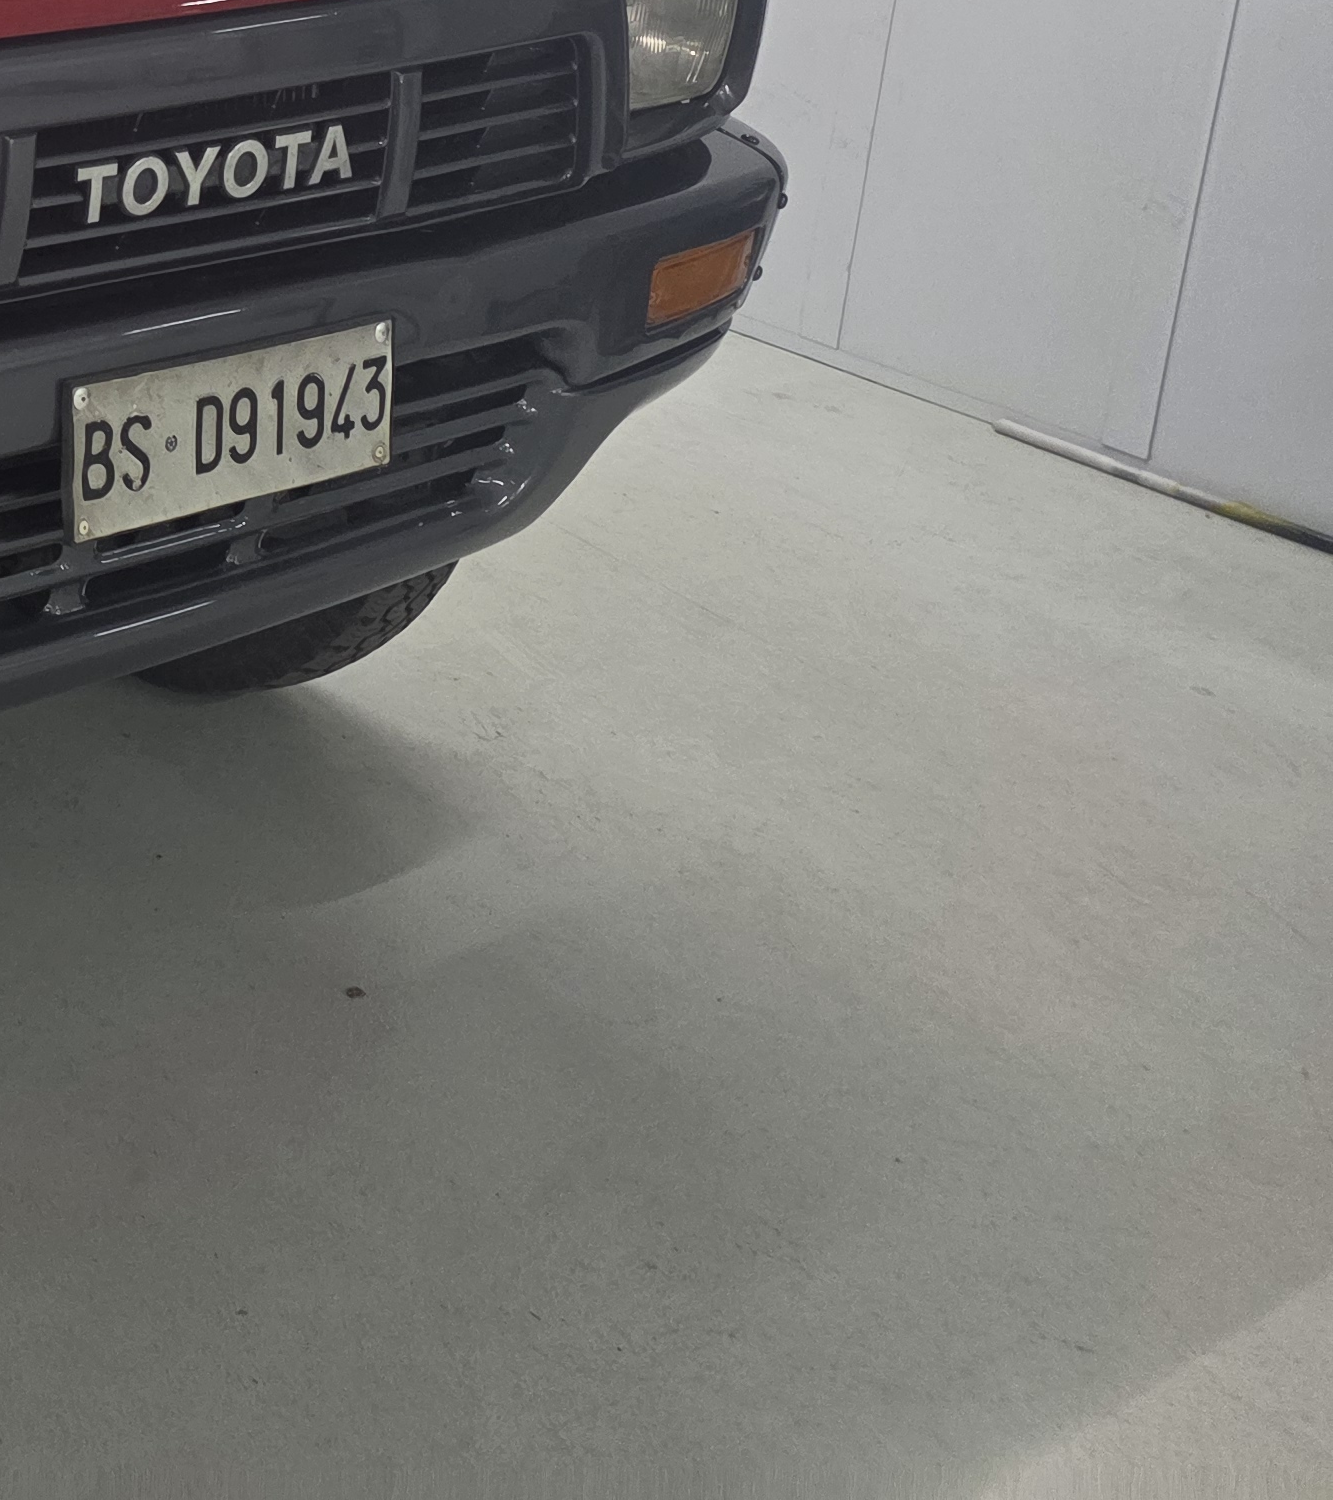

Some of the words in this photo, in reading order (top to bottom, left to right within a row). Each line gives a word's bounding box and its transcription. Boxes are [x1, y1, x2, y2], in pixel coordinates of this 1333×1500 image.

[76, 124, 353, 224] TOYOTA
[80, 414, 153, 502] BS
[194, 355, 389, 476] D91943
